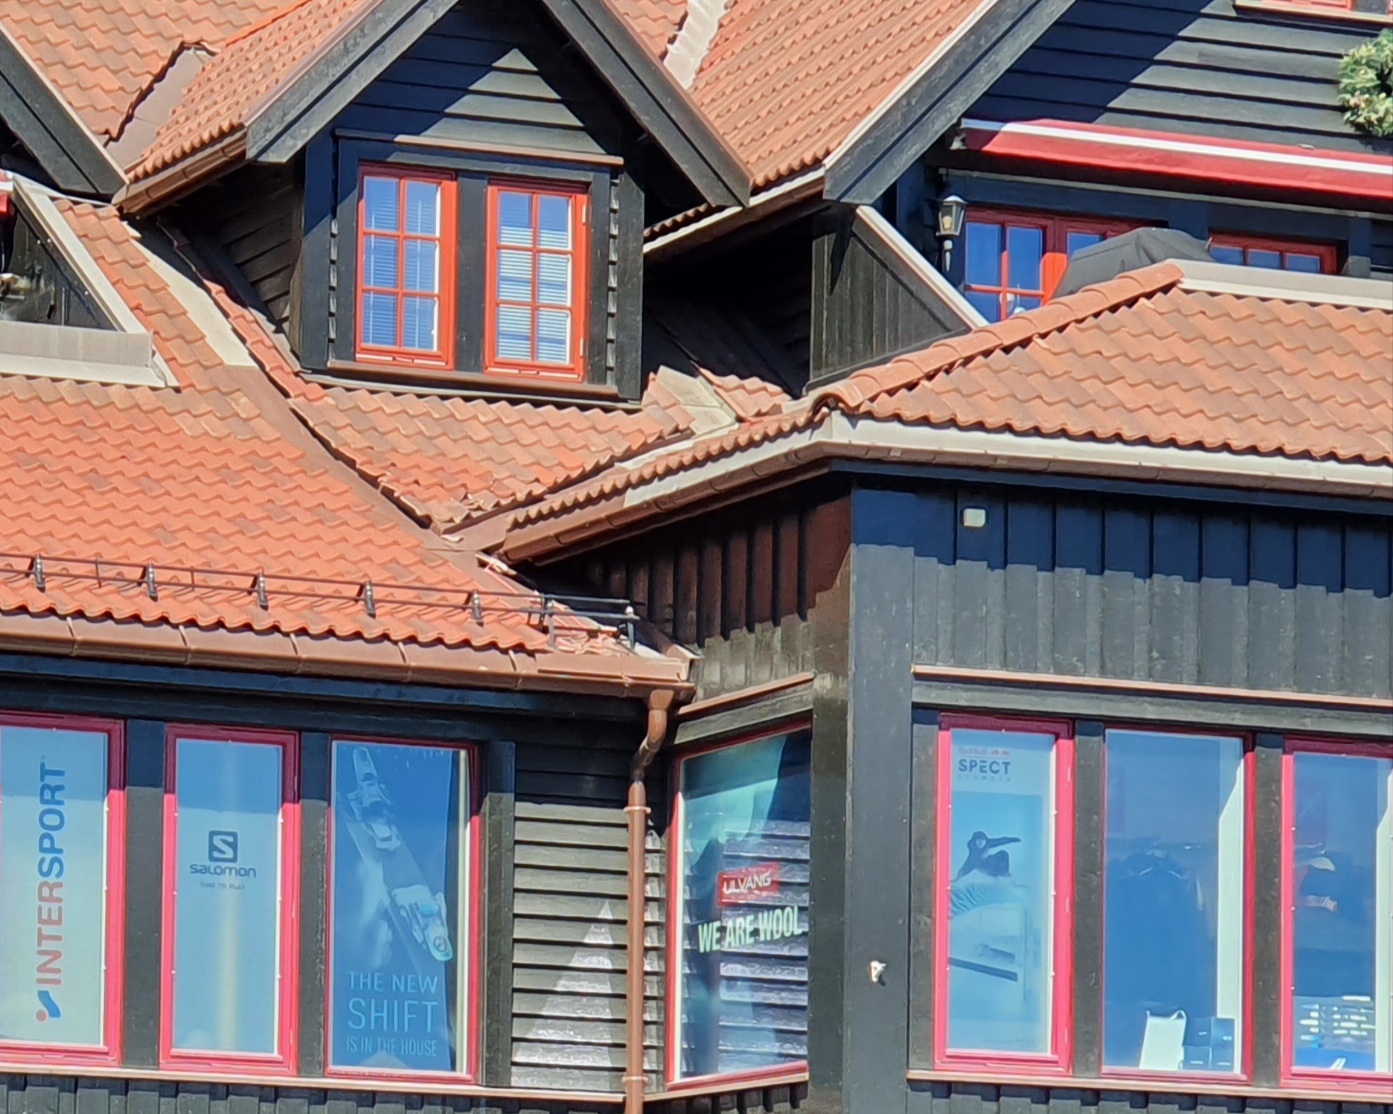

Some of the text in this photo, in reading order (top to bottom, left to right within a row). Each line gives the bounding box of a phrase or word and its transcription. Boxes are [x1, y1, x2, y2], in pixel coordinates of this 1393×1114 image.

[958, 758, 1011, 776] SPECT
[35, 761, 66, 986] INTERSPORT
[722, 870, 773, 895] ULVANG
[698, 904, 804, 953] WE ARE WOOL
[349, 971, 439, 994] THE NEW
[348, 997, 439, 1033] SHIFT
[348, 1036, 438, 1057] IS IN THE HOUSE
